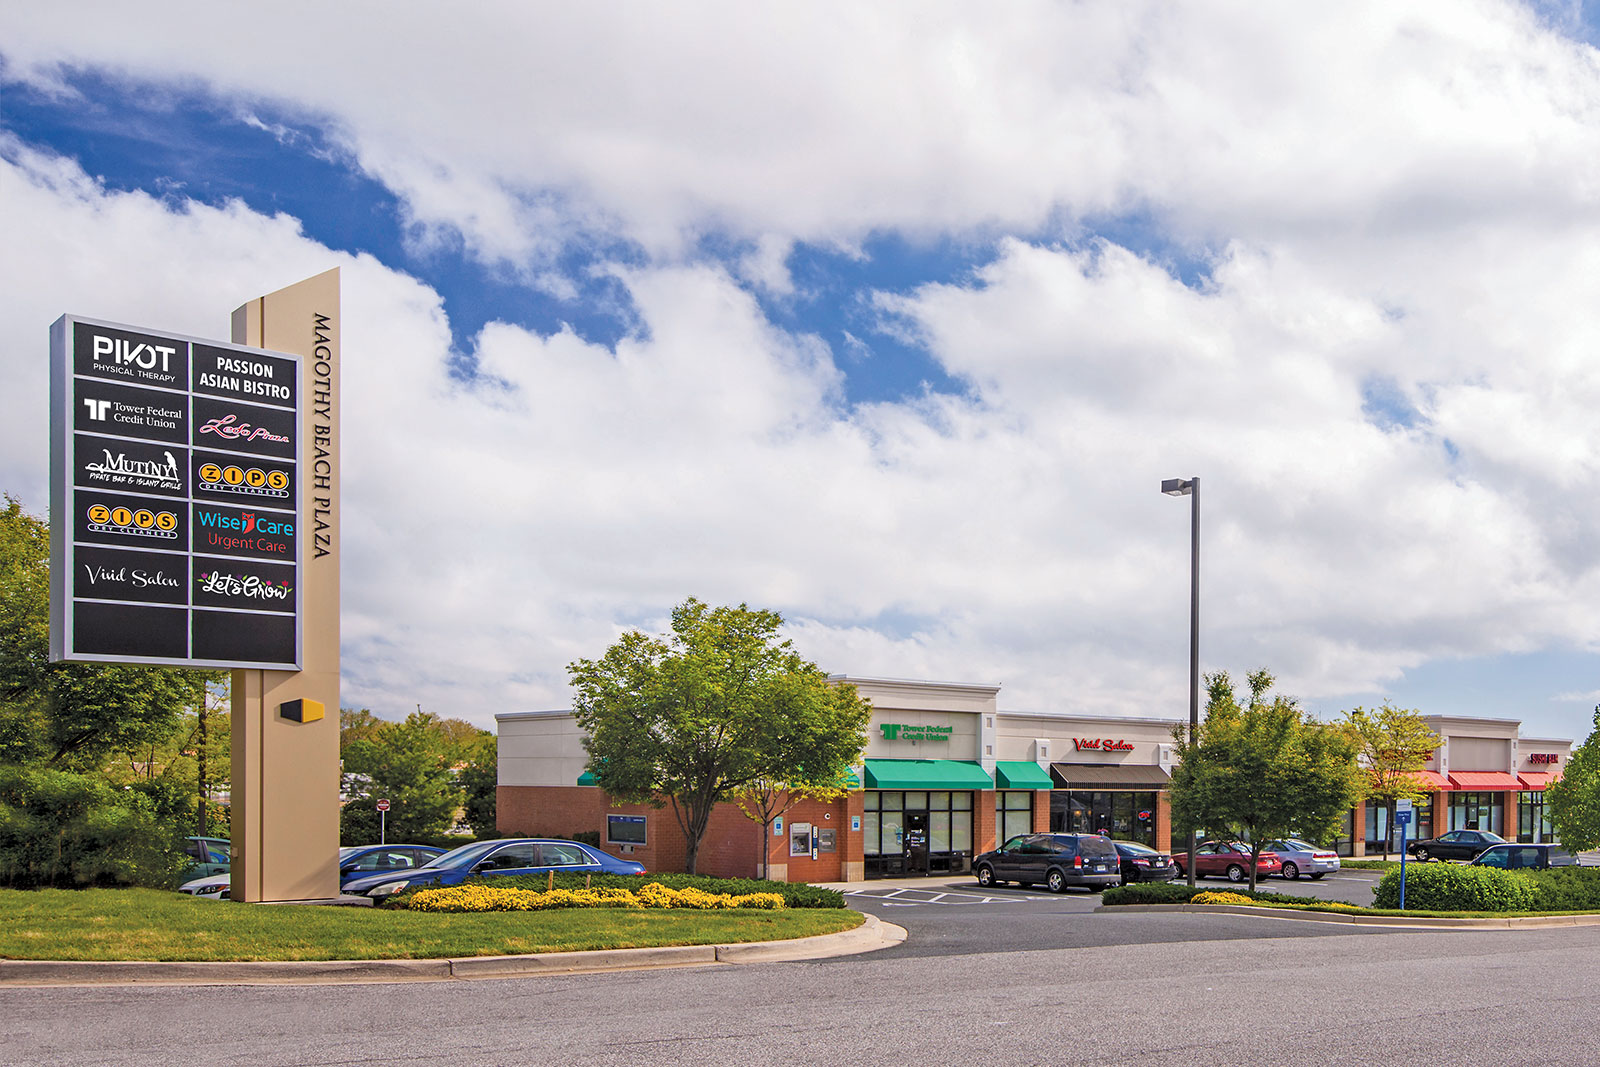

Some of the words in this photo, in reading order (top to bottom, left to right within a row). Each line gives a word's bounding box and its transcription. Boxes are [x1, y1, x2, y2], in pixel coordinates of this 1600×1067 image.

[93, 335, 176, 372] PIVOT
[93, 363, 134, 377] PHYSICAL
[137, 370, 176, 383] THERAPY
[217, 356, 273, 378] PASSION
[313, 312, 332, 421] MAGOTHY
[200, 372, 240, 391] ASIAN
[243, 380, 290, 399] BISTRO
[113, 401, 145, 414] Tower
[147, 406, 182, 419] Federal
[113, 413, 144, 424] Credit
[146, 417, 176, 429] Union
[313, 423, 332, 491] BEACH
[89, 472, 111, 482] PIRATE
[112, 475, 126, 483] BAR
[127, 476, 135, 484] &
[136, 477, 160, 488] ISLAND
[160, 481, 182, 491] GRILLE
[203, 465, 285, 488] ZIPS
[231, 486, 284, 497] CLEANERS
[92, 507, 173, 529] ZIPS
[198, 511, 241, 530] Wise
[256, 518, 294, 536] Care
[312, 497, 332, 560] PLAZA
[120, 528, 172, 538] CLEANERS
[208, 531, 254, 550] Urgent
[256, 538, 287, 553] Care
[84, 564, 127, 585] Vivid
[131, 569, 180, 588] Salon
[202, 570, 243, 597] Let's
[240, 575, 288, 600] Grow
[902, 724, 926, 733] Tower
[926, 725, 953, 734] Federal
[902, 732, 925, 740] Credit
[925, 733, 949, 741] Union
[1073, 737, 1101, 752] Vivid
[1102, 739, 1135, 752] Salon
